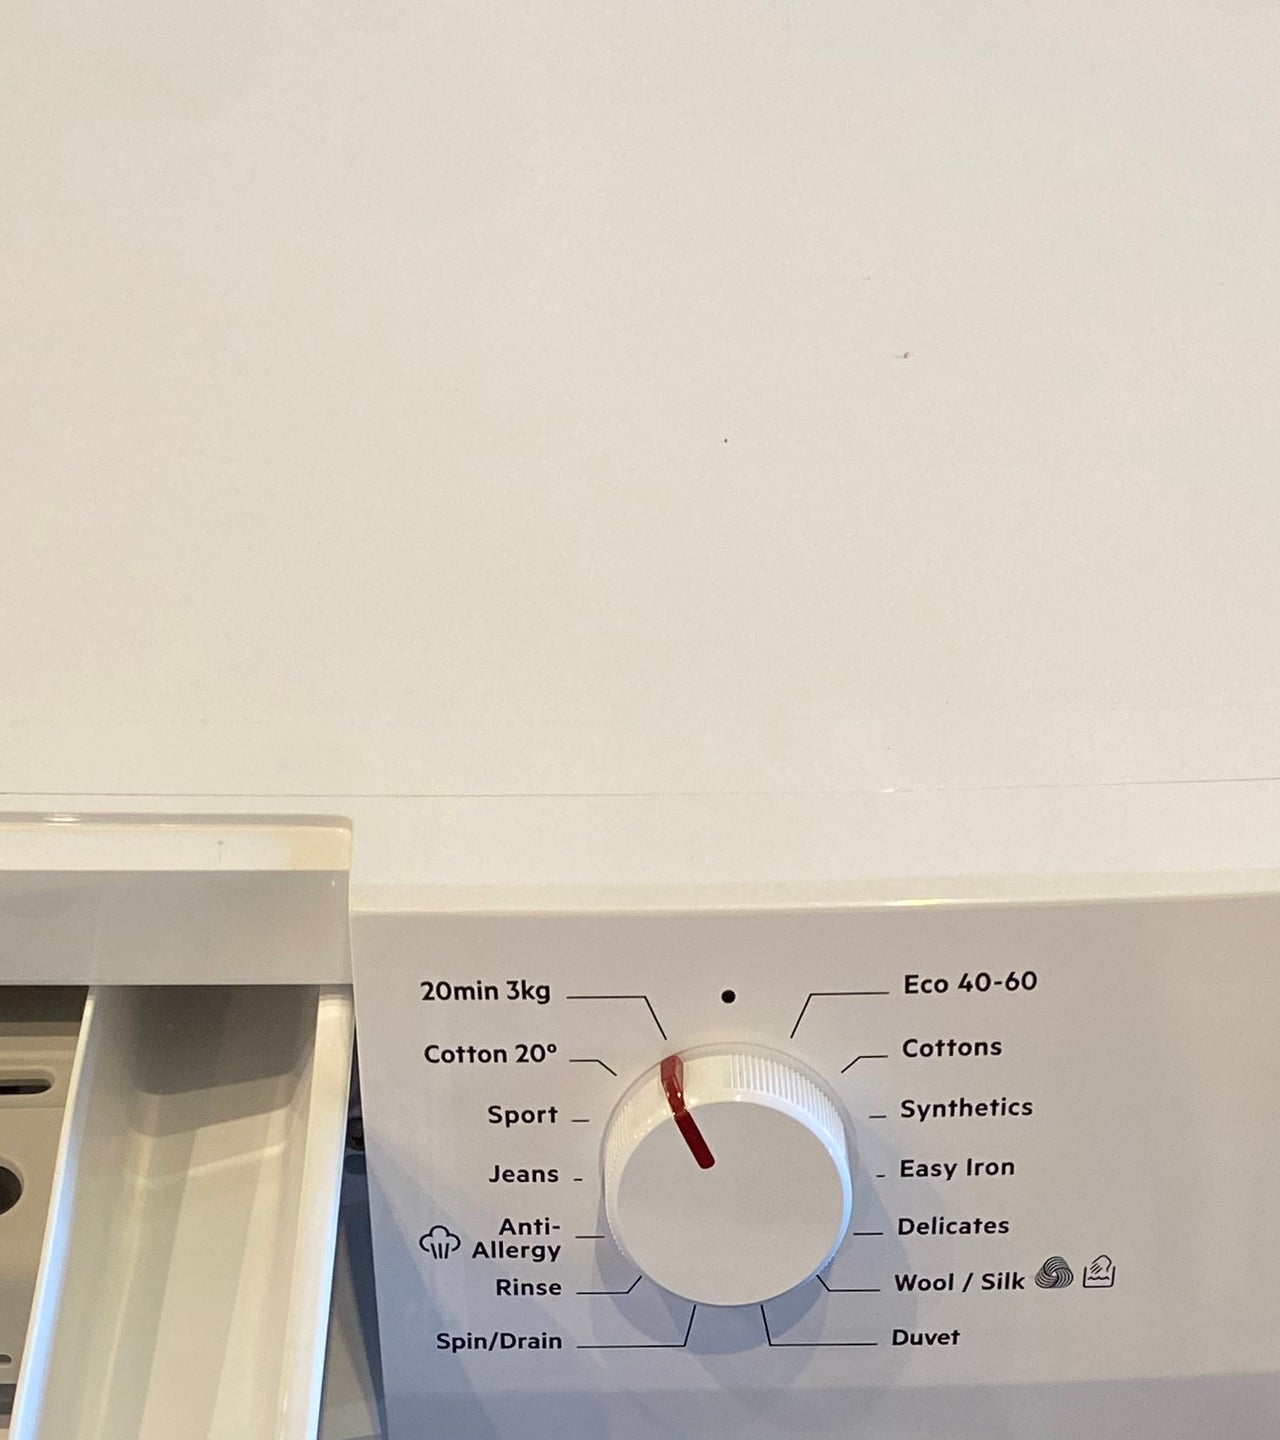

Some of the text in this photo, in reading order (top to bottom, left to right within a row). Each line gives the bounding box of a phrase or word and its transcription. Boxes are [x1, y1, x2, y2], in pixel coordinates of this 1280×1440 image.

[420, 979, 551, 1005] 20min 3kg
[904, 970, 1038, 995] Eco 40-60
[424, 1043, 557, 1064] Cotton 20°
[902, 1038, 1002, 1058] Cottons
[487, 1105, 559, 1129] Sport
[900, 1096, 1033, 1123] Synthetics
[488, 1164, 559, 1183] Jeans
[900, 1157, 1015, 1181] Easy Iron
[498, 1216, 561, 1236] Anti-
[897, 1216, 1010, 1236] Delicates
[471, 1240, 562, 1263] Allergy
[496, 1278, 562, 1296] Rinse
[894, 1272, 954, 1292] Wool
[981, 1271, 1026, 1291] Silk
[436, 1331, 562, 1354] Spin/Drain
[891, 1328, 961, 1346] Duvet
